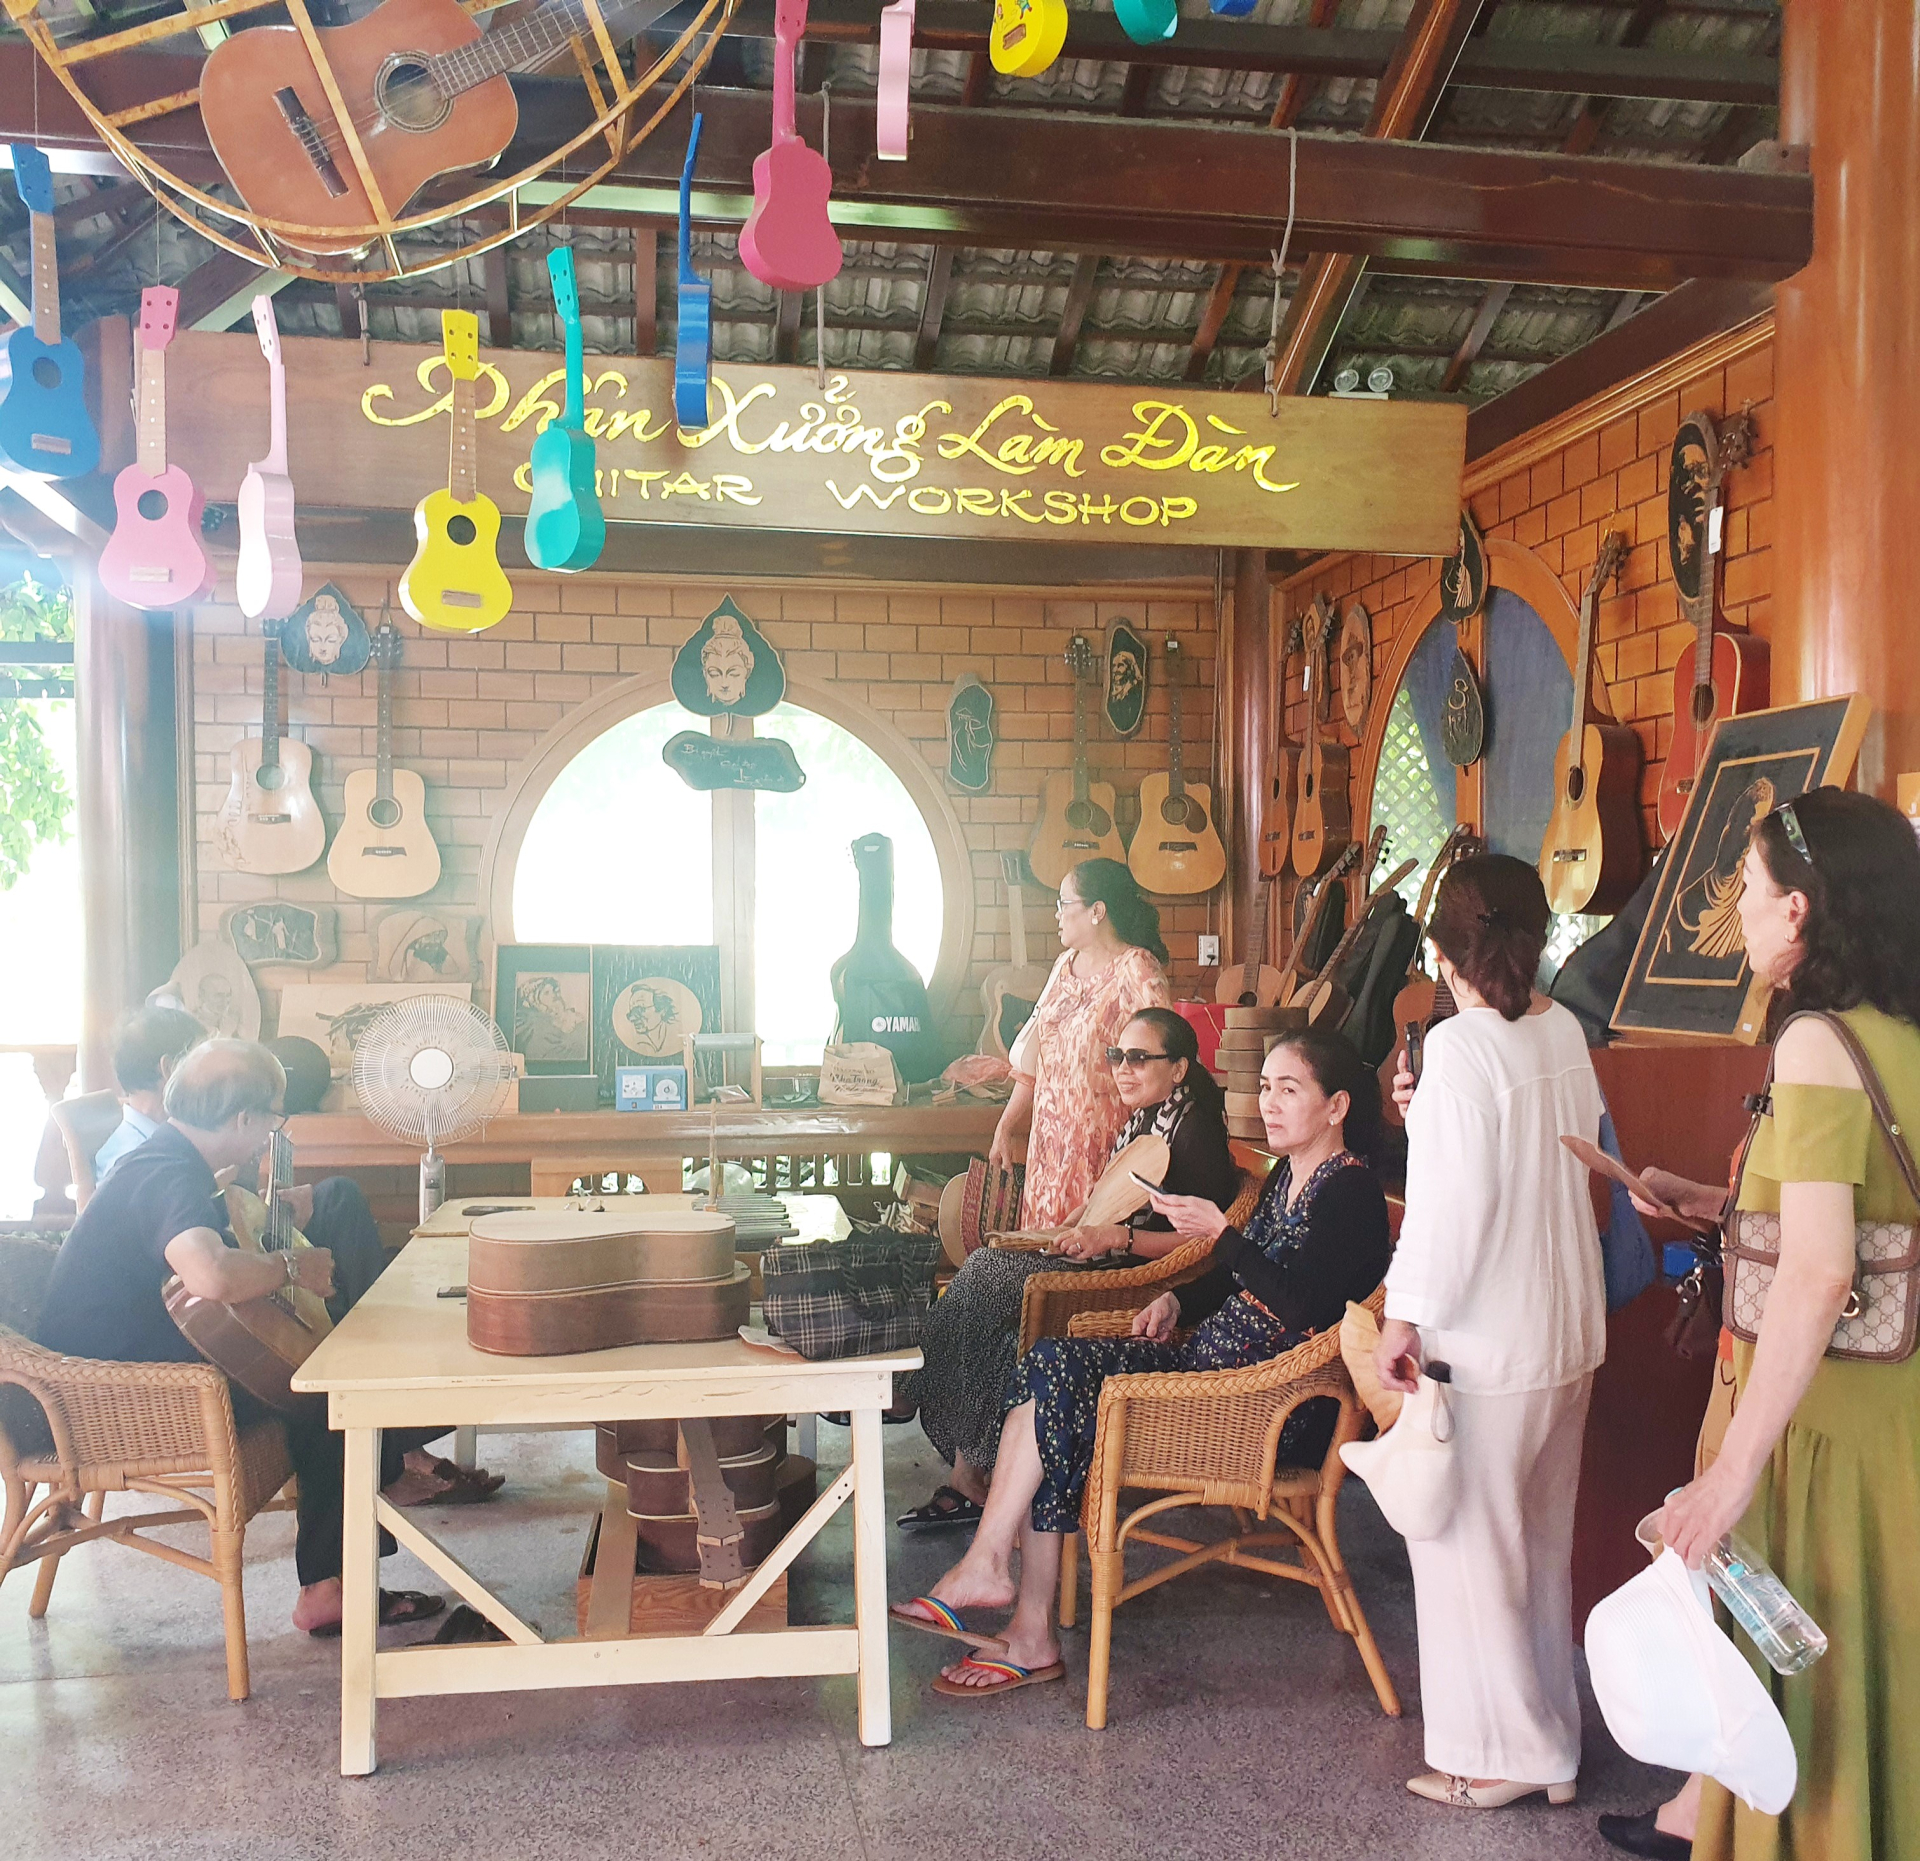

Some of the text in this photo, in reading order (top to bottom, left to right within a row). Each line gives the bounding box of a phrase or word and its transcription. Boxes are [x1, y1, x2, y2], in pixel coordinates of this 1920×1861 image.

[937, 394, 1086, 478] Làm
[1100, 400, 1300, 493] Đàn
[825, 479, 1199, 527] WORKSHOP
